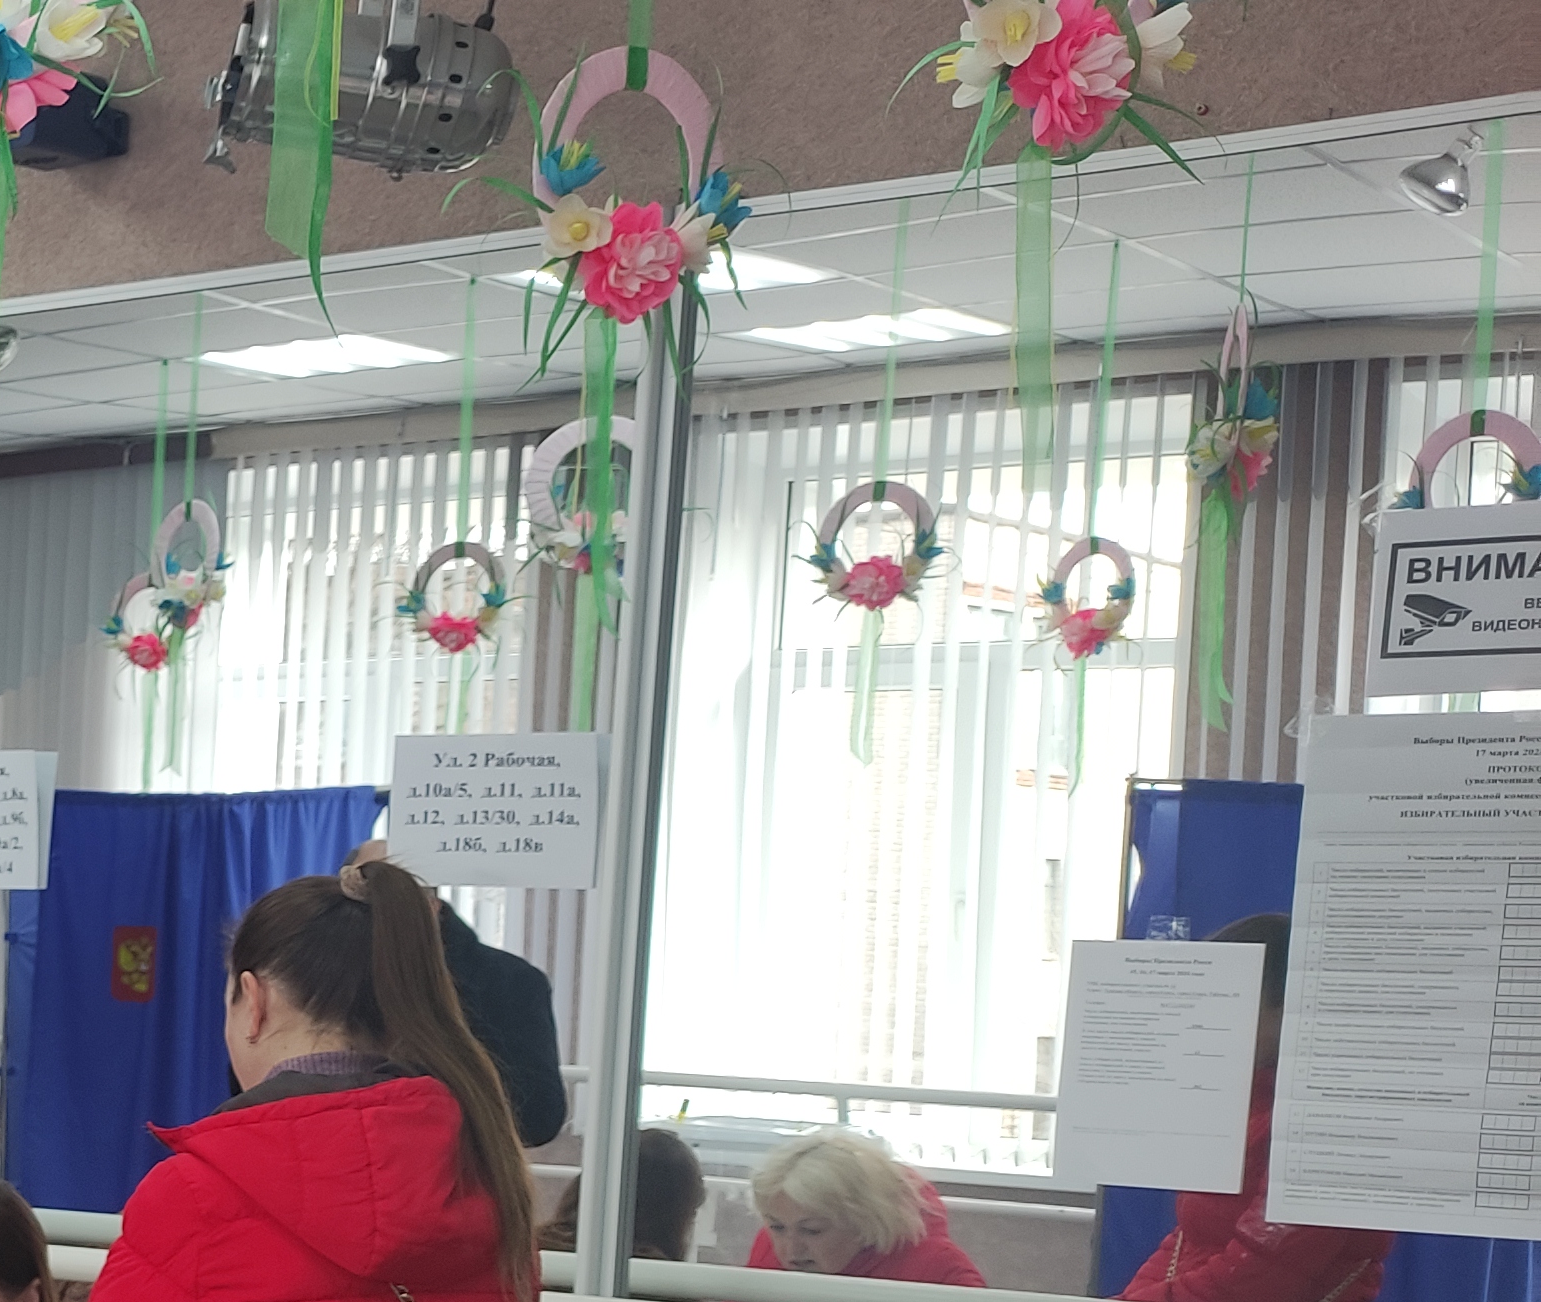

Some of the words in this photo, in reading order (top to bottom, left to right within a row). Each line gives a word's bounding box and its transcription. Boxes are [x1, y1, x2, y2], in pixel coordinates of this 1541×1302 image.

[1472, 618, 1541, 632] ВИДЕОН
[1413, 737, 1454, 745] Выборы
[1457, 735, 1515, 745] Президента
[432, 753, 463, 767] Ул.
[468, 753, 477, 767] 2
[484, 752, 561, 768] Рабочая,
[1476, 749, 1486, 757] 17
[480, 783, 522, 799] д.11,
[530, 783, 581, 799] д.11а,
[405, 810, 445, 826] д.12,
[454, 810, 520, 826] д.13/30,
[528, 810, 580, 826] д.14а,
